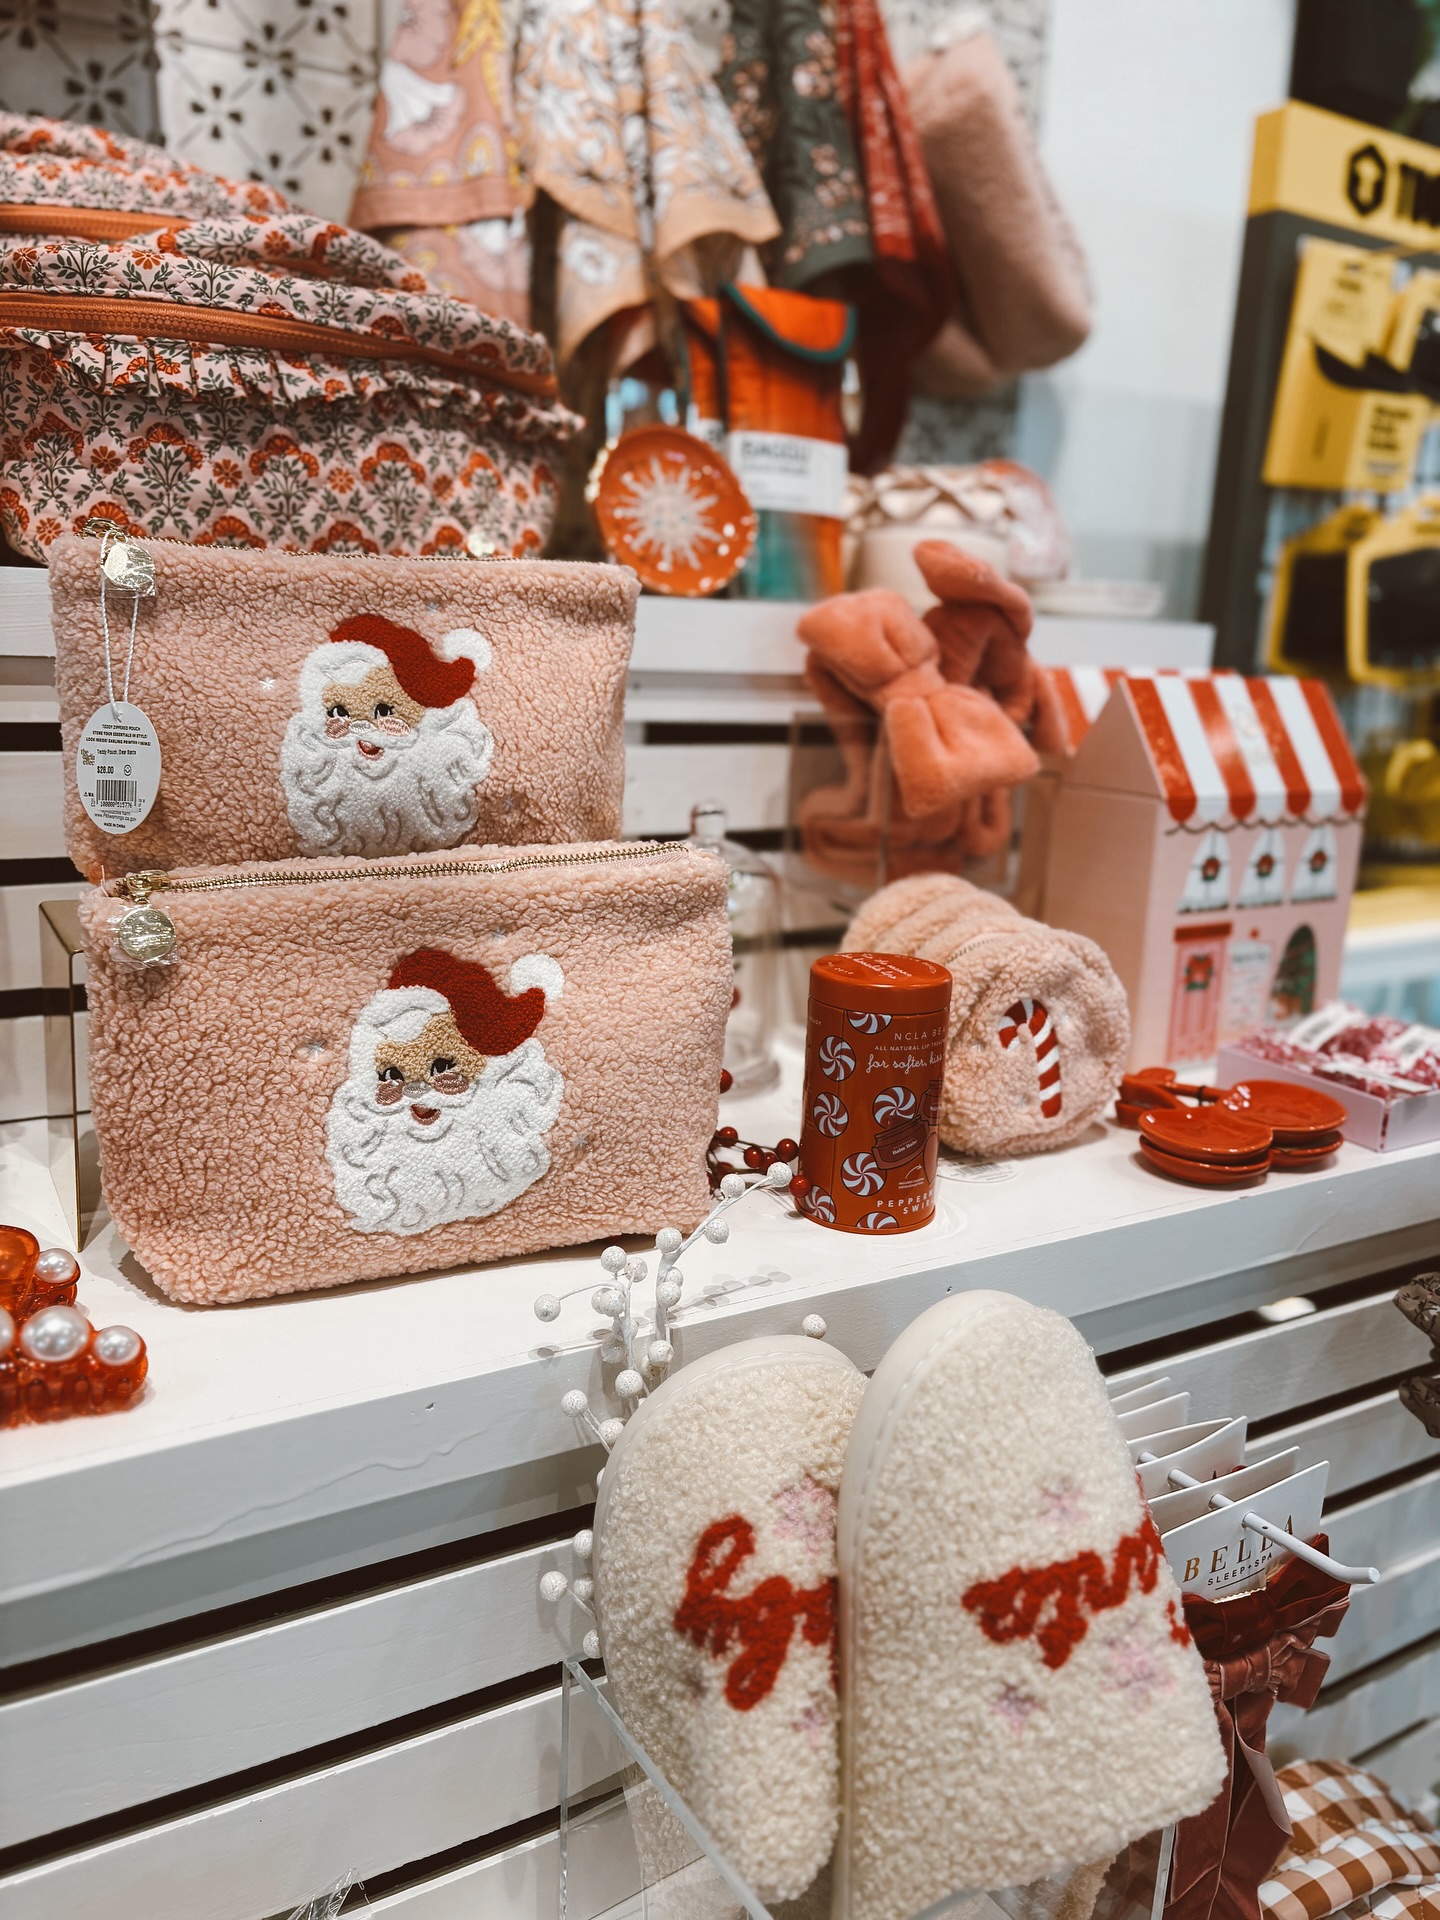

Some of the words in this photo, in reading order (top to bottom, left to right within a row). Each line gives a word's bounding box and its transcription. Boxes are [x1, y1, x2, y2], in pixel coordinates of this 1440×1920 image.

[97, 766, 114, 774] $28.00
[894, 1031, 927, 1040] NCLA
[866, 1053, 889, 1073] for
[893, 1054, 927, 1074] softer,
